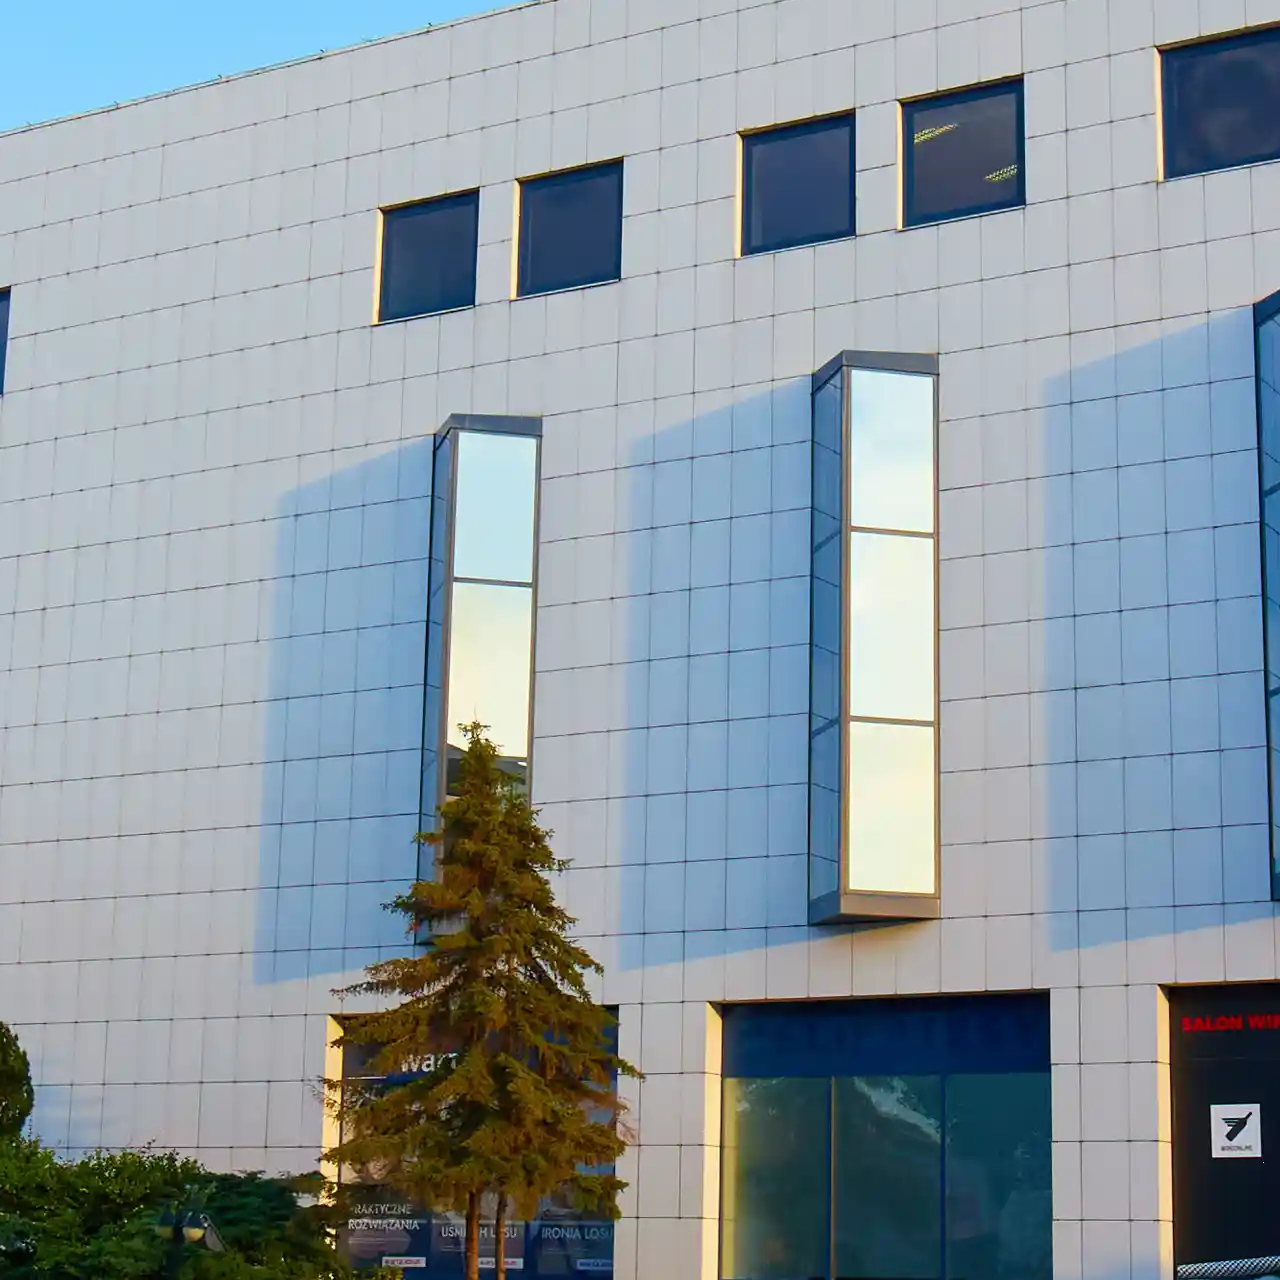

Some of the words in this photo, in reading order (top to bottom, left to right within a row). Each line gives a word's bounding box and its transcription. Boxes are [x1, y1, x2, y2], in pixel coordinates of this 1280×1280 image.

[1181, 1014, 1243, 1032] SALON
[350, 1203, 413, 1215] RAKTYCZNE
[490, 1226, 518, 1238] LSU
[541, 1227, 582, 1240] IRONIA
